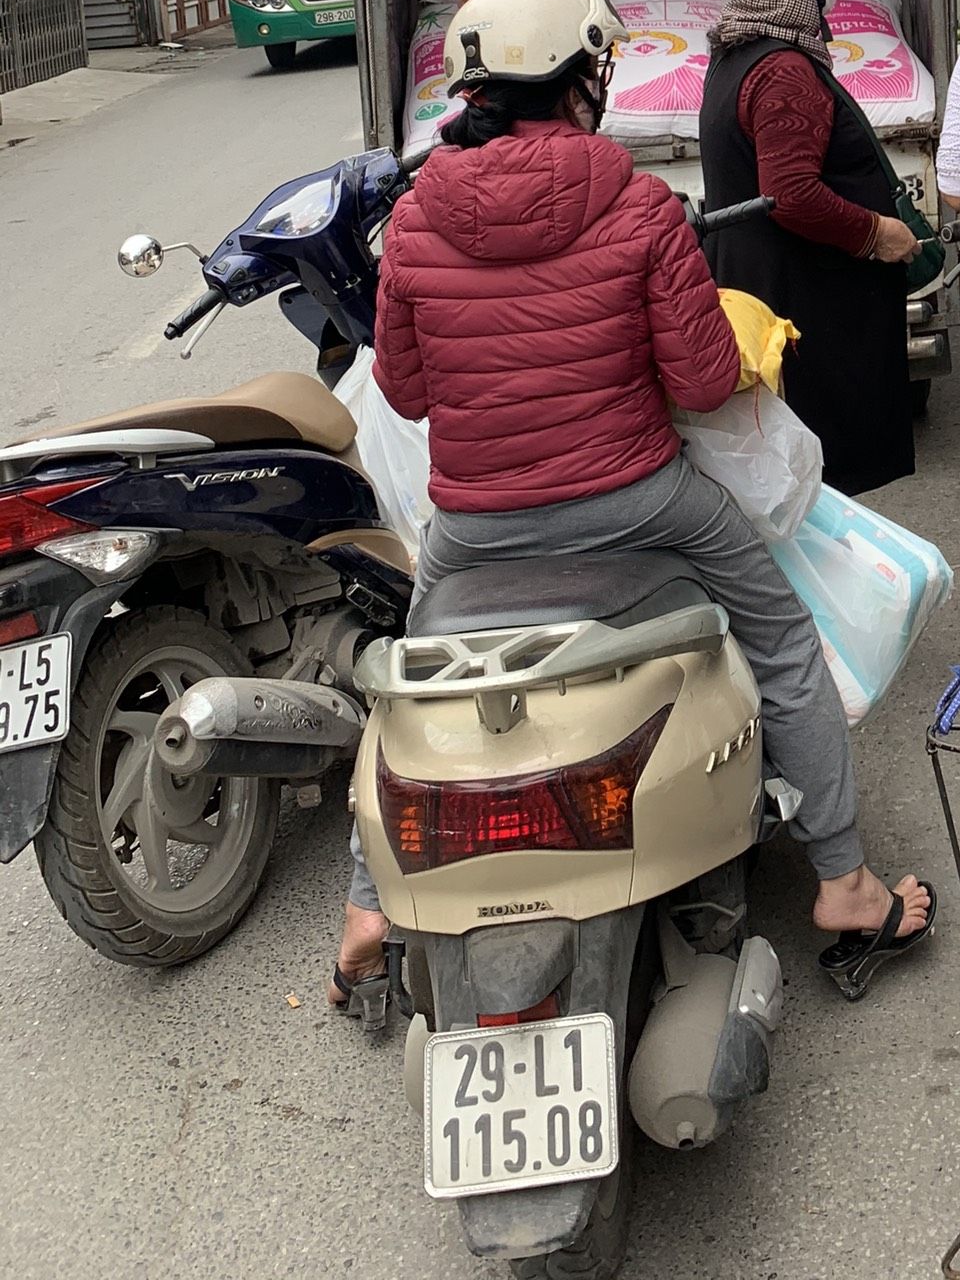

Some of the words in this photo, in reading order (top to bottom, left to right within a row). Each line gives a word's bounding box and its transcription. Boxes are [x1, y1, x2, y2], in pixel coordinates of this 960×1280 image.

[163, 466, 286, 492] VISION
[0, 643, 52, 691] -L5
[477, 900, 554, 918] HONDA
[453, 1028, 585, 1108] 29-L1
[442, 1100, 603, 1183] 115.08
